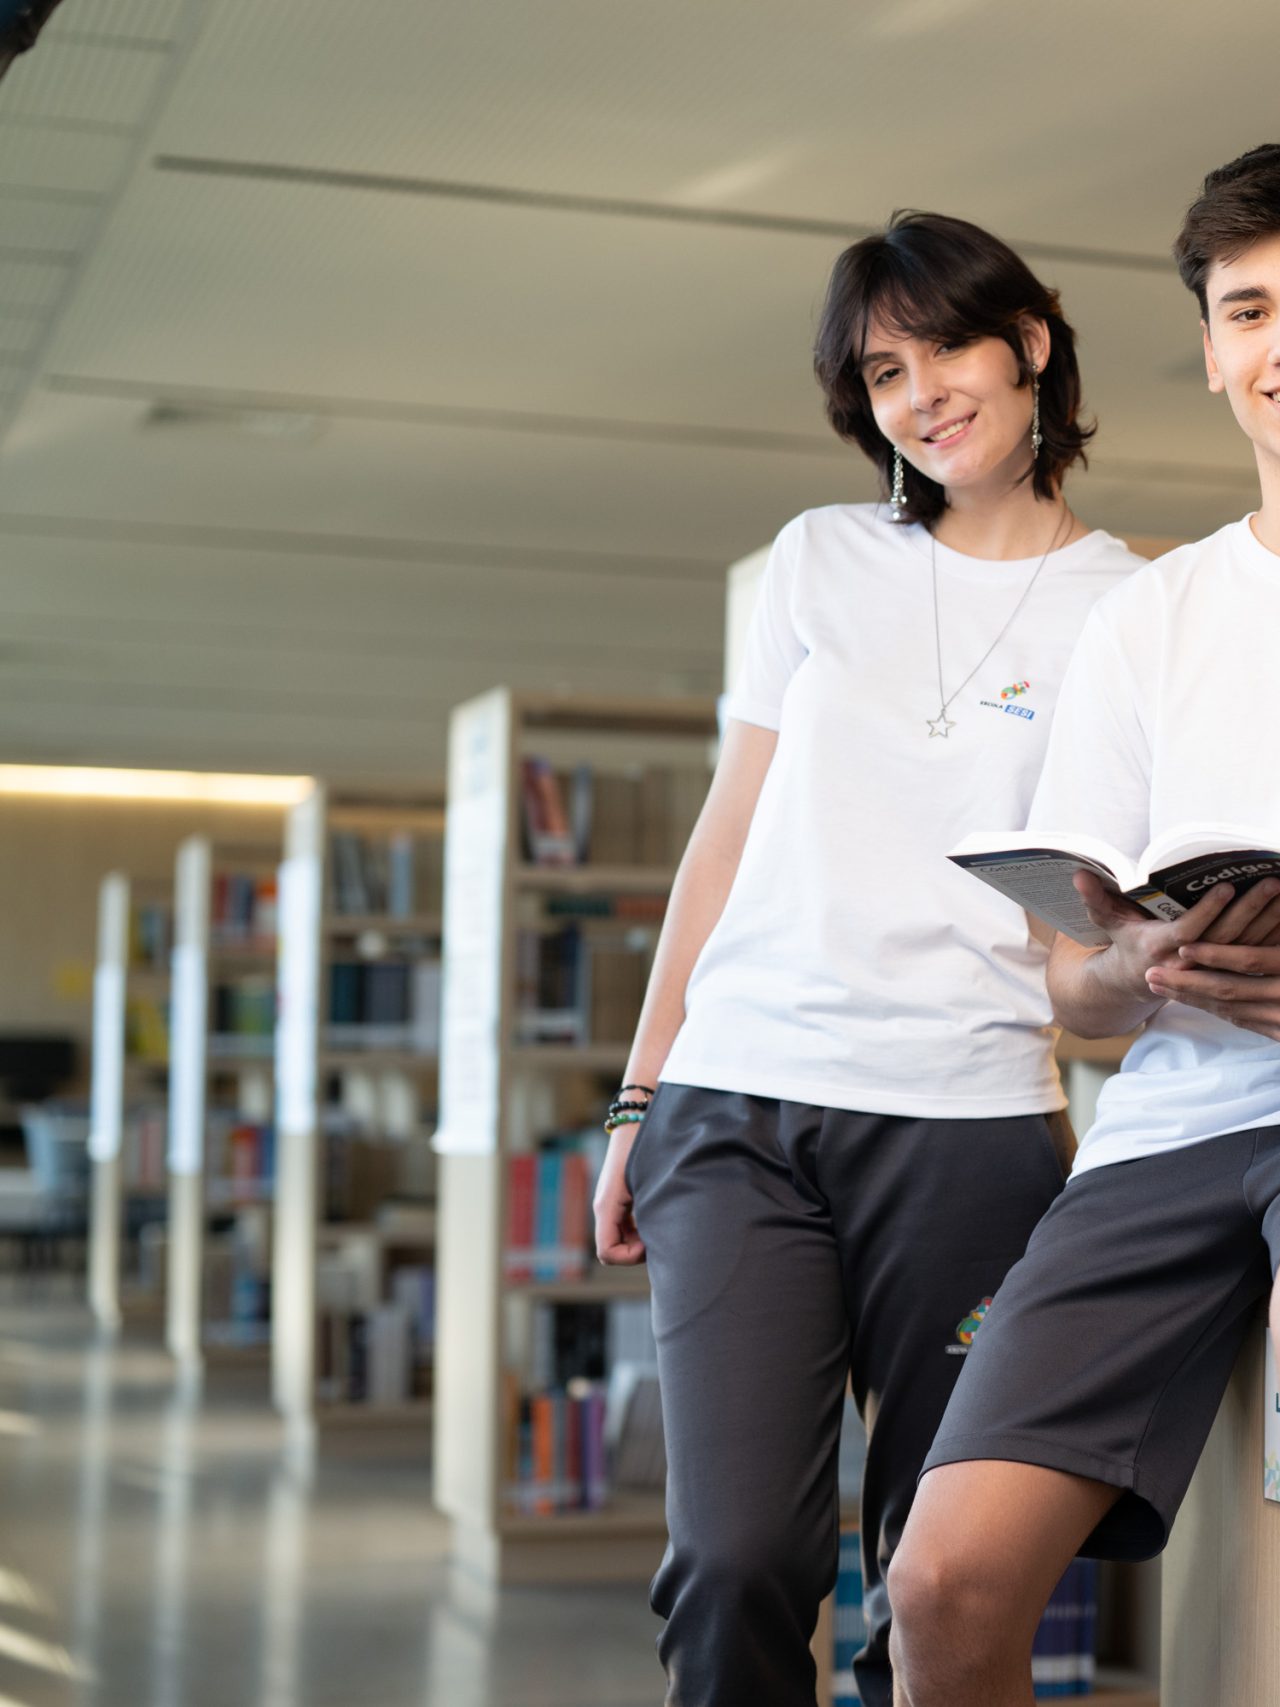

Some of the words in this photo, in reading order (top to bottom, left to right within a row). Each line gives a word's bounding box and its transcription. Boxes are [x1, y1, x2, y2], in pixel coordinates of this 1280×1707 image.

[1006, 704, 1034, 719] SESI
[1186, 862, 1273, 893] Código
[1157, 902, 1184, 922] Códig
